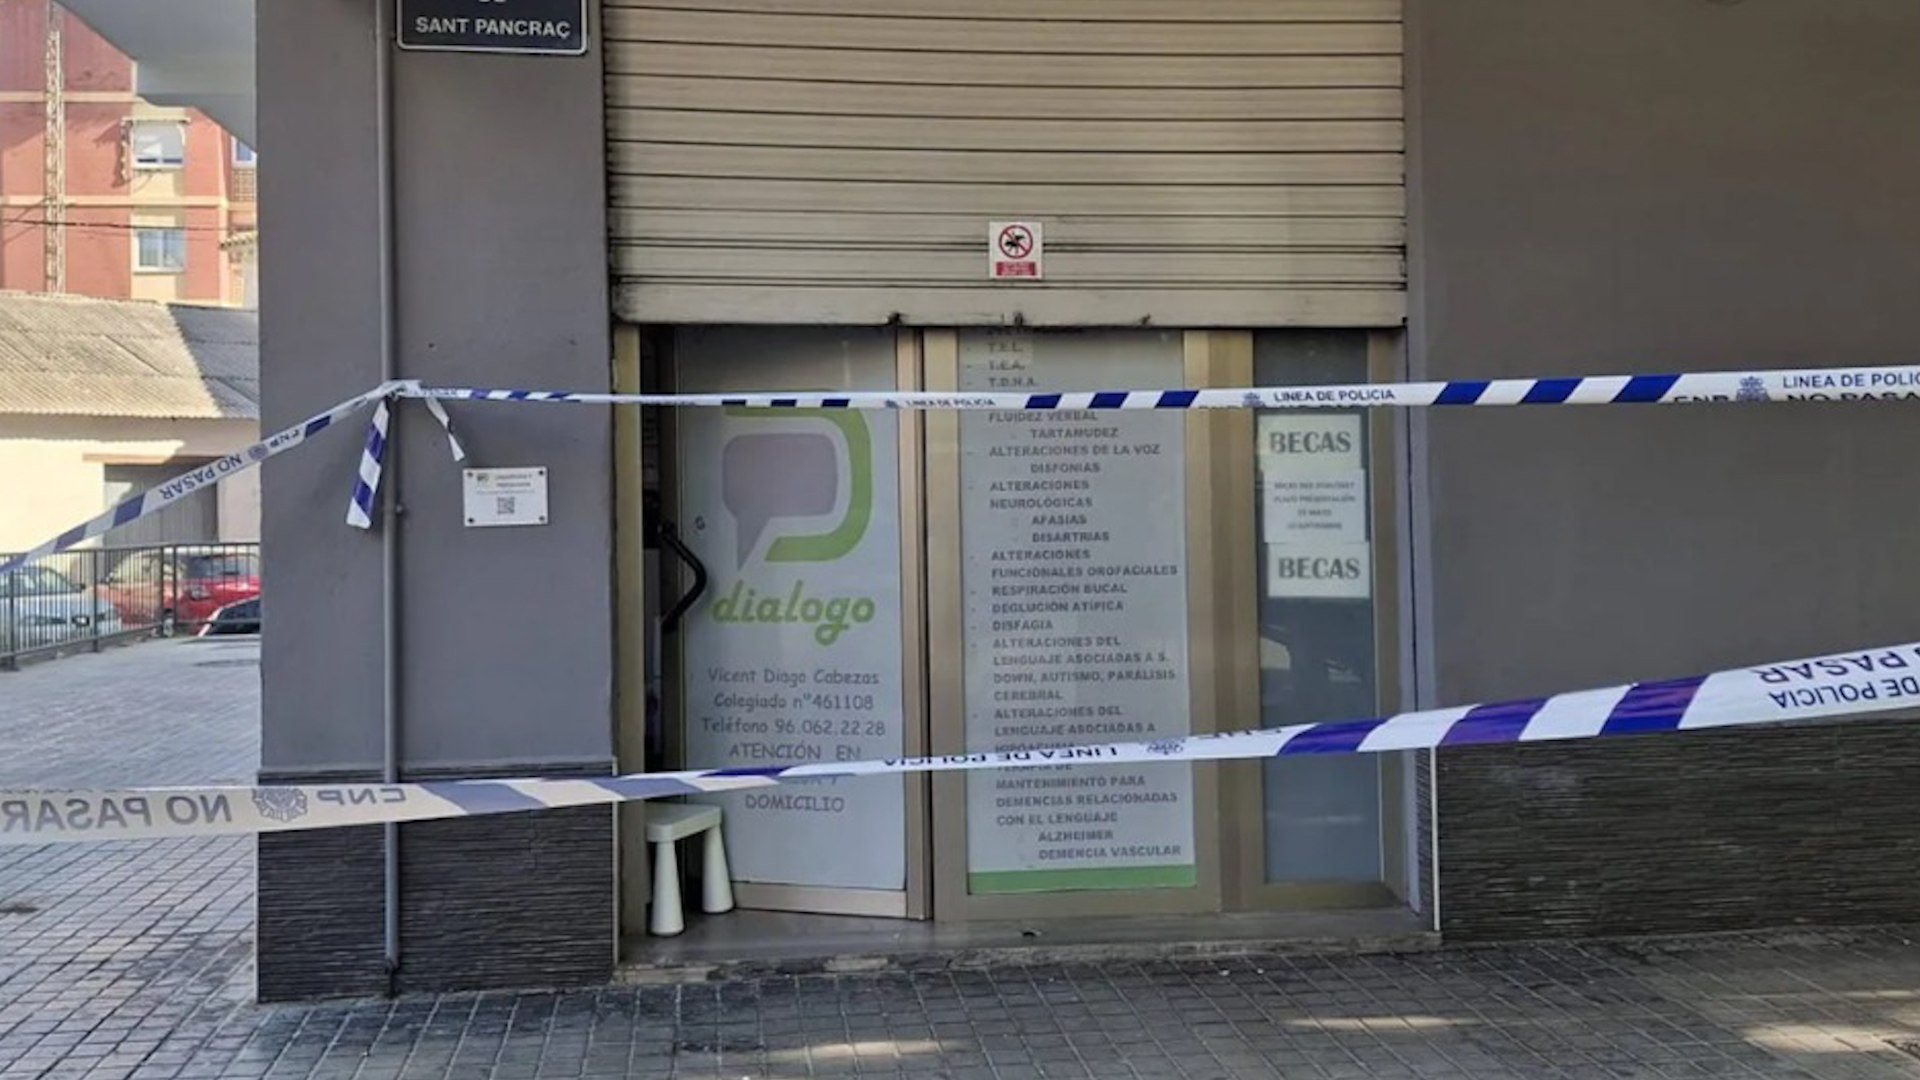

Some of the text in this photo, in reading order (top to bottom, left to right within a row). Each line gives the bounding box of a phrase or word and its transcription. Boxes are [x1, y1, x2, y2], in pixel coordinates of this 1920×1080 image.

[415, 17, 571, 39] SANT PANCRAÇ
[1783, 374, 1835, 389] LINEA
[1841, 374, 1865, 387] DE
[1273, 389, 1395, 402] LINEA DE POLICIA
[988, 411, 1098, 423] FLUIDEZ VERBAL
[1031, 428, 1119, 439] TARTAMUDEZ
[1269, 430, 1352, 454] BECAS
[989, 443, 1161, 457] ALTERACIONES DE LA VOZ
[1030, 463, 1101, 474] DISFONIAS
[158, 453, 243, 501] NO PASAR
[989, 481, 1090, 492] ALTERACIONES
[1032, 514, 1087, 525] AFASIAS
[1032, 532, 1110, 543] DISARTRIAS
[991, 549, 1091, 561] ALTERACIONES
[991, 564, 1178, 579] FUNCIONALES OROFACIALES
[1278, 556, 1361, 580] BECAS
[1083, 583, 1128, 594] BUCAL
[712, 579, 875, 646] dialogo
[993, 636, 1121, 649] ALTERACIONES DEL
[993, 654, 1063, 666] LENGUAJE
[1066, 652, 1142, 664] ASOCIADAS
[1144, 652, 1154, 662] A
[1751, 651, 1909, 684] PASAR
[708, 667, 757, 683] Vicent
[813, 668, 880, 685] Cabezas
[994, 690, 1063, 702] CEREBRAL
[1768, 676, 1920, 708] DE POLICIA
[714, 693, 786, 712] Colegiado
[994, 705, 1122, 719] ALTERACIONES DEL
[701, 717, 768, 734] Teléfono
[994, 723, 1156, 737] LENGUAJE ASOCIADAS A
[729, 741, 861, 761] ATENCIÓN EN
[995, 776, 1146, 790] MANTENIMIENTO PARA
[745, 794, 845, 812] DOMICILIO
[996, 793, 1178, 808] DEMENCIAS RELACIONADAS
[996, 812, 1118, 827] CON EL LENGUAJE
[1038, 830, 1114, 843] ALZHEIMER
[1039, 845, 1182, 860] DEMENCIA VASCULAR
